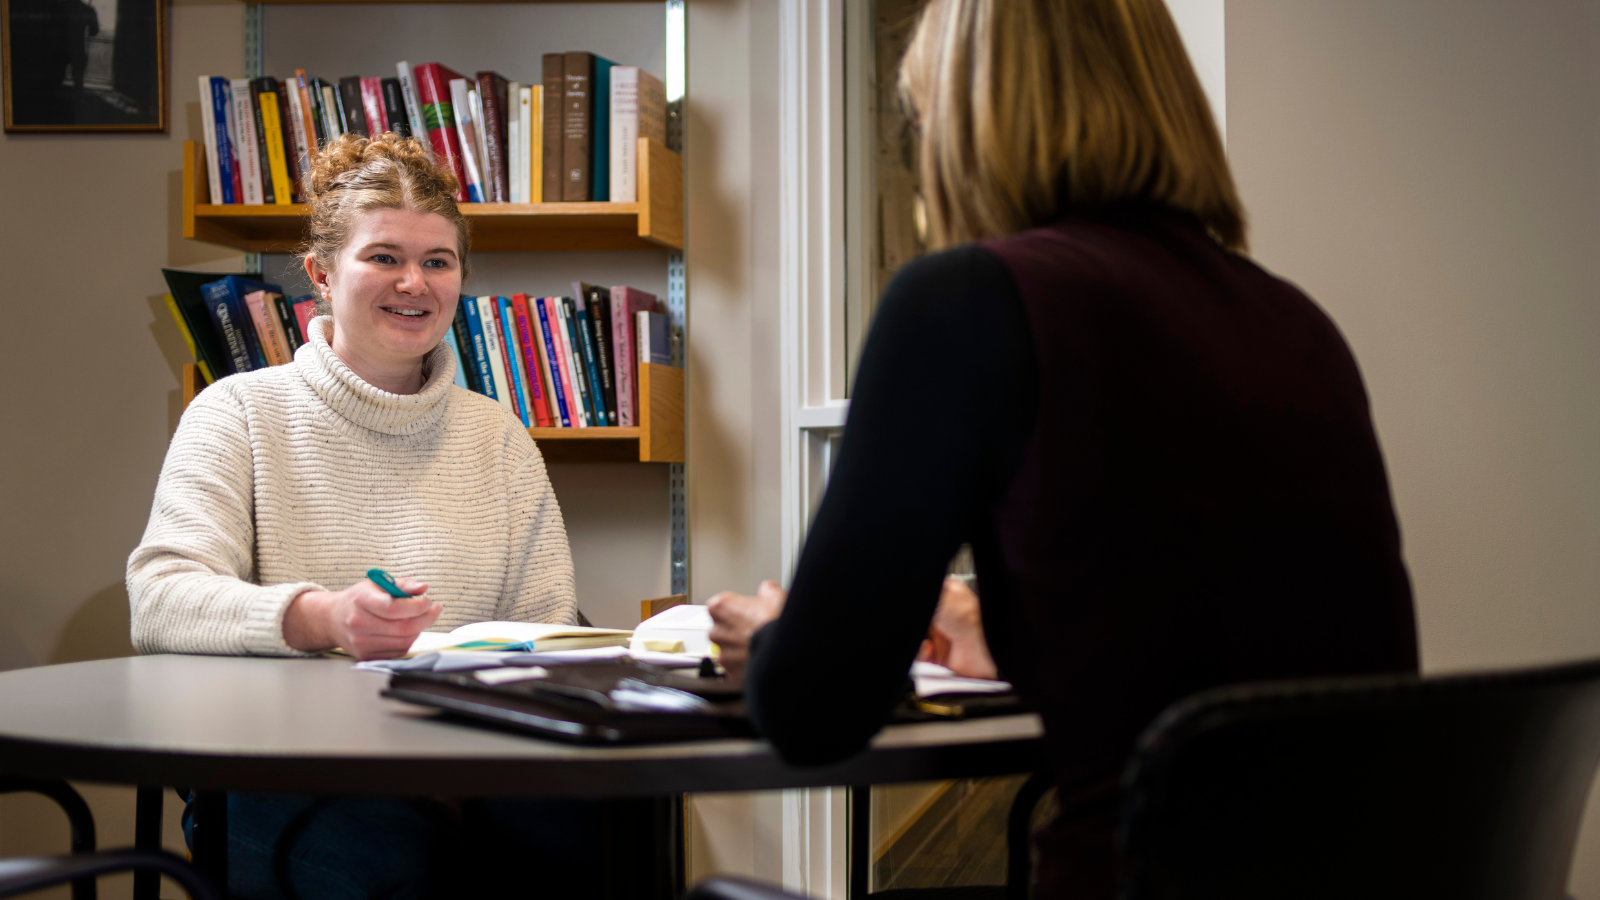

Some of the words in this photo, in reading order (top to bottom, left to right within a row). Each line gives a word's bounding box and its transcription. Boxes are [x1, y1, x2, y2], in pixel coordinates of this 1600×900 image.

[216, 303, 241, 354] QUALITATIVE
[594, 320, 603, 336] Doing
[472, 334, 485, 360] Writing
[518, 315, 529, 344] BEYOND
[524, 345, 541, 399] METHODOLOGY
[598, 342, 607, 367] Literature
[480, 361, 488, 373] the
[602, 369, 610, 388] Review
[483, 374, 493, 395] Social
